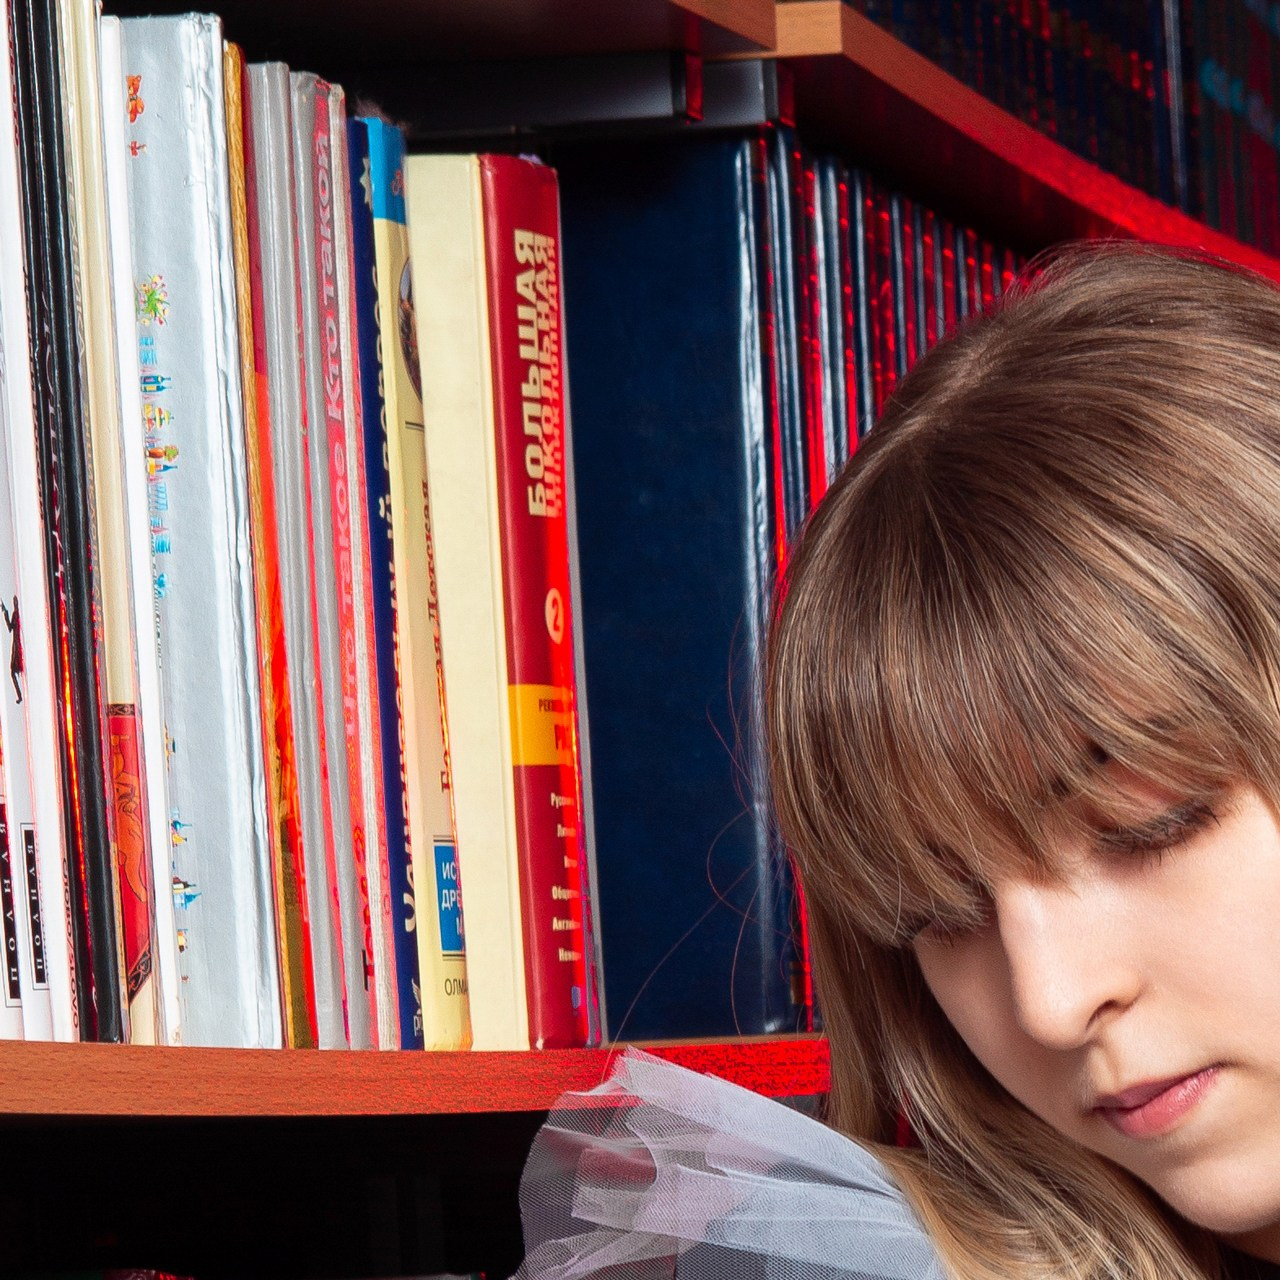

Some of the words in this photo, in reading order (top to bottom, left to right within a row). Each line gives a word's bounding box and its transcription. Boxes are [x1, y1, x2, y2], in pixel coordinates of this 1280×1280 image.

[315, 131, 334, 304] такой
[325, 317, 341, 422] Кто
[514, 228, 549, 518] БОЛЬШАЯ
[334, 441, 355, 614] такое
[26, 844, 43, 970] ПОЛНАЯ
